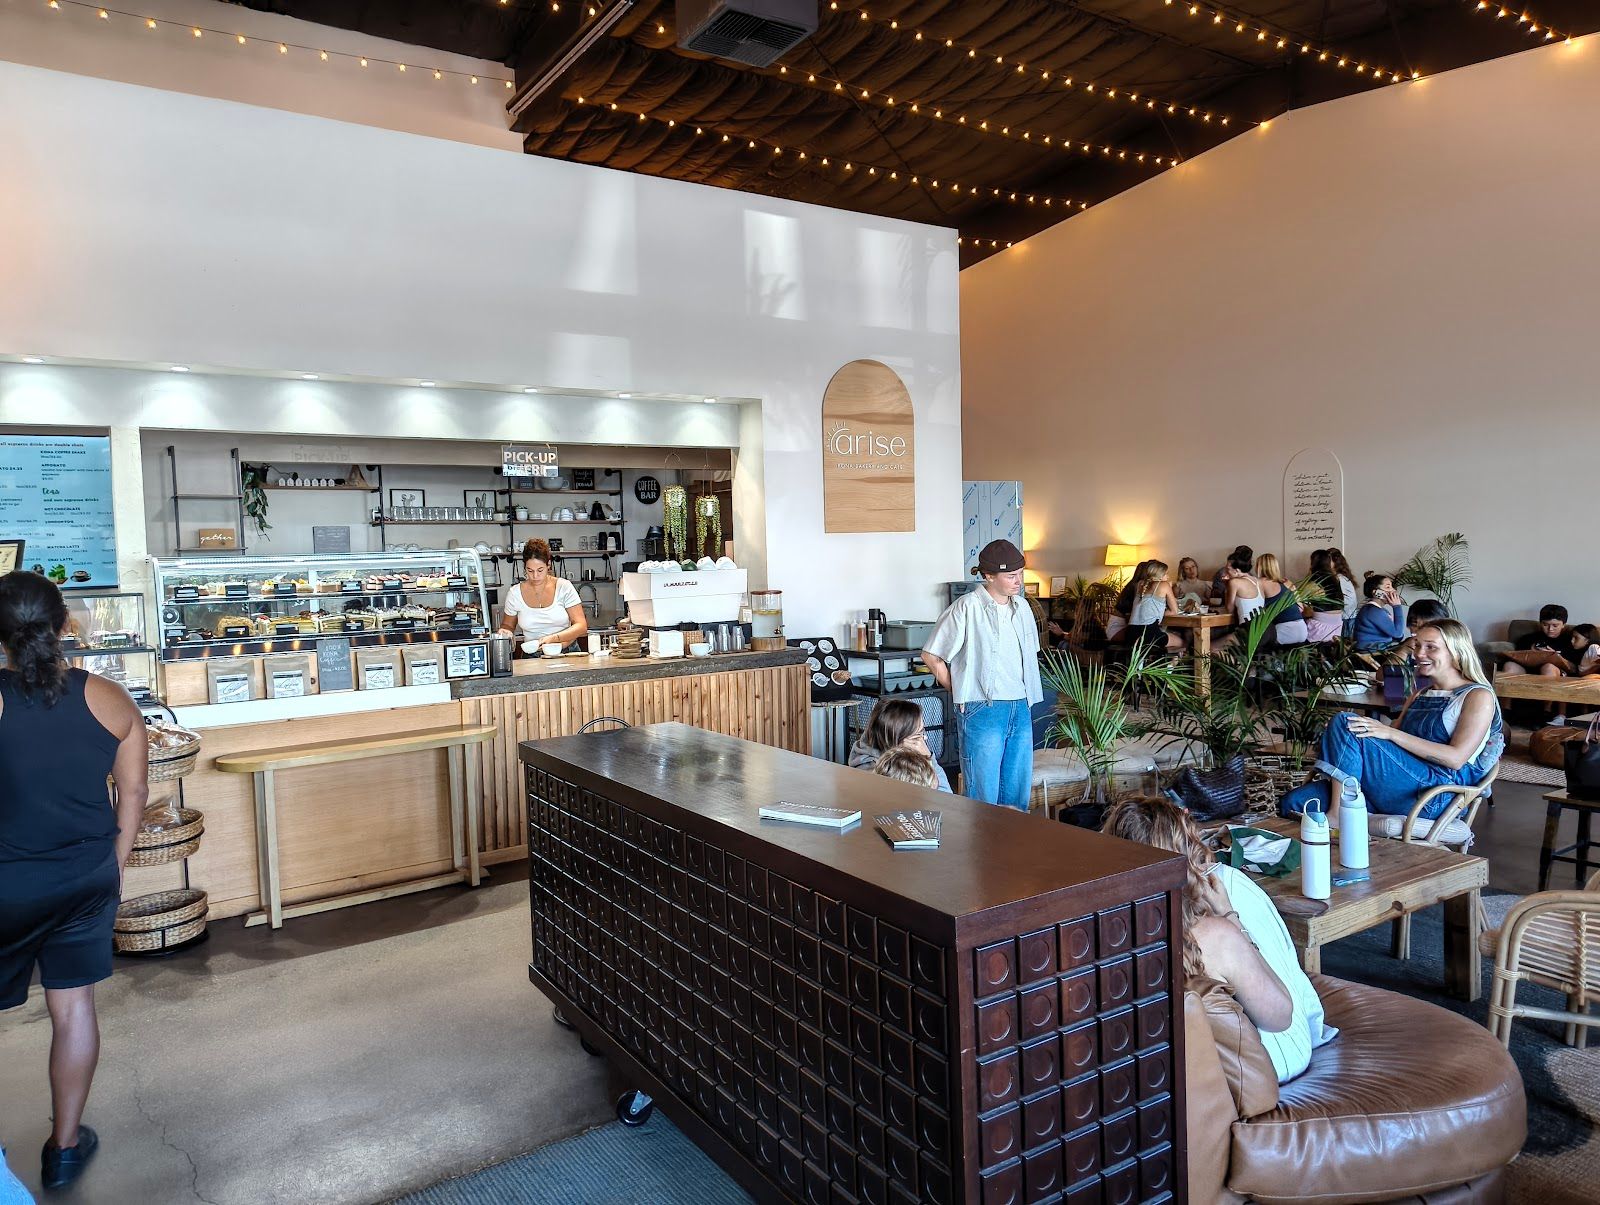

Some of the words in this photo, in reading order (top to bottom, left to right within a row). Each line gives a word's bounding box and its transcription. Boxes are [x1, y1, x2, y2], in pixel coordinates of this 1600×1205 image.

[832, 429, 906, 457] arise
[503, 451, 557, 464] PICK-UP
[637, 480, 658, 491] COFFEE
[640, 491, 657, 499] BAR
